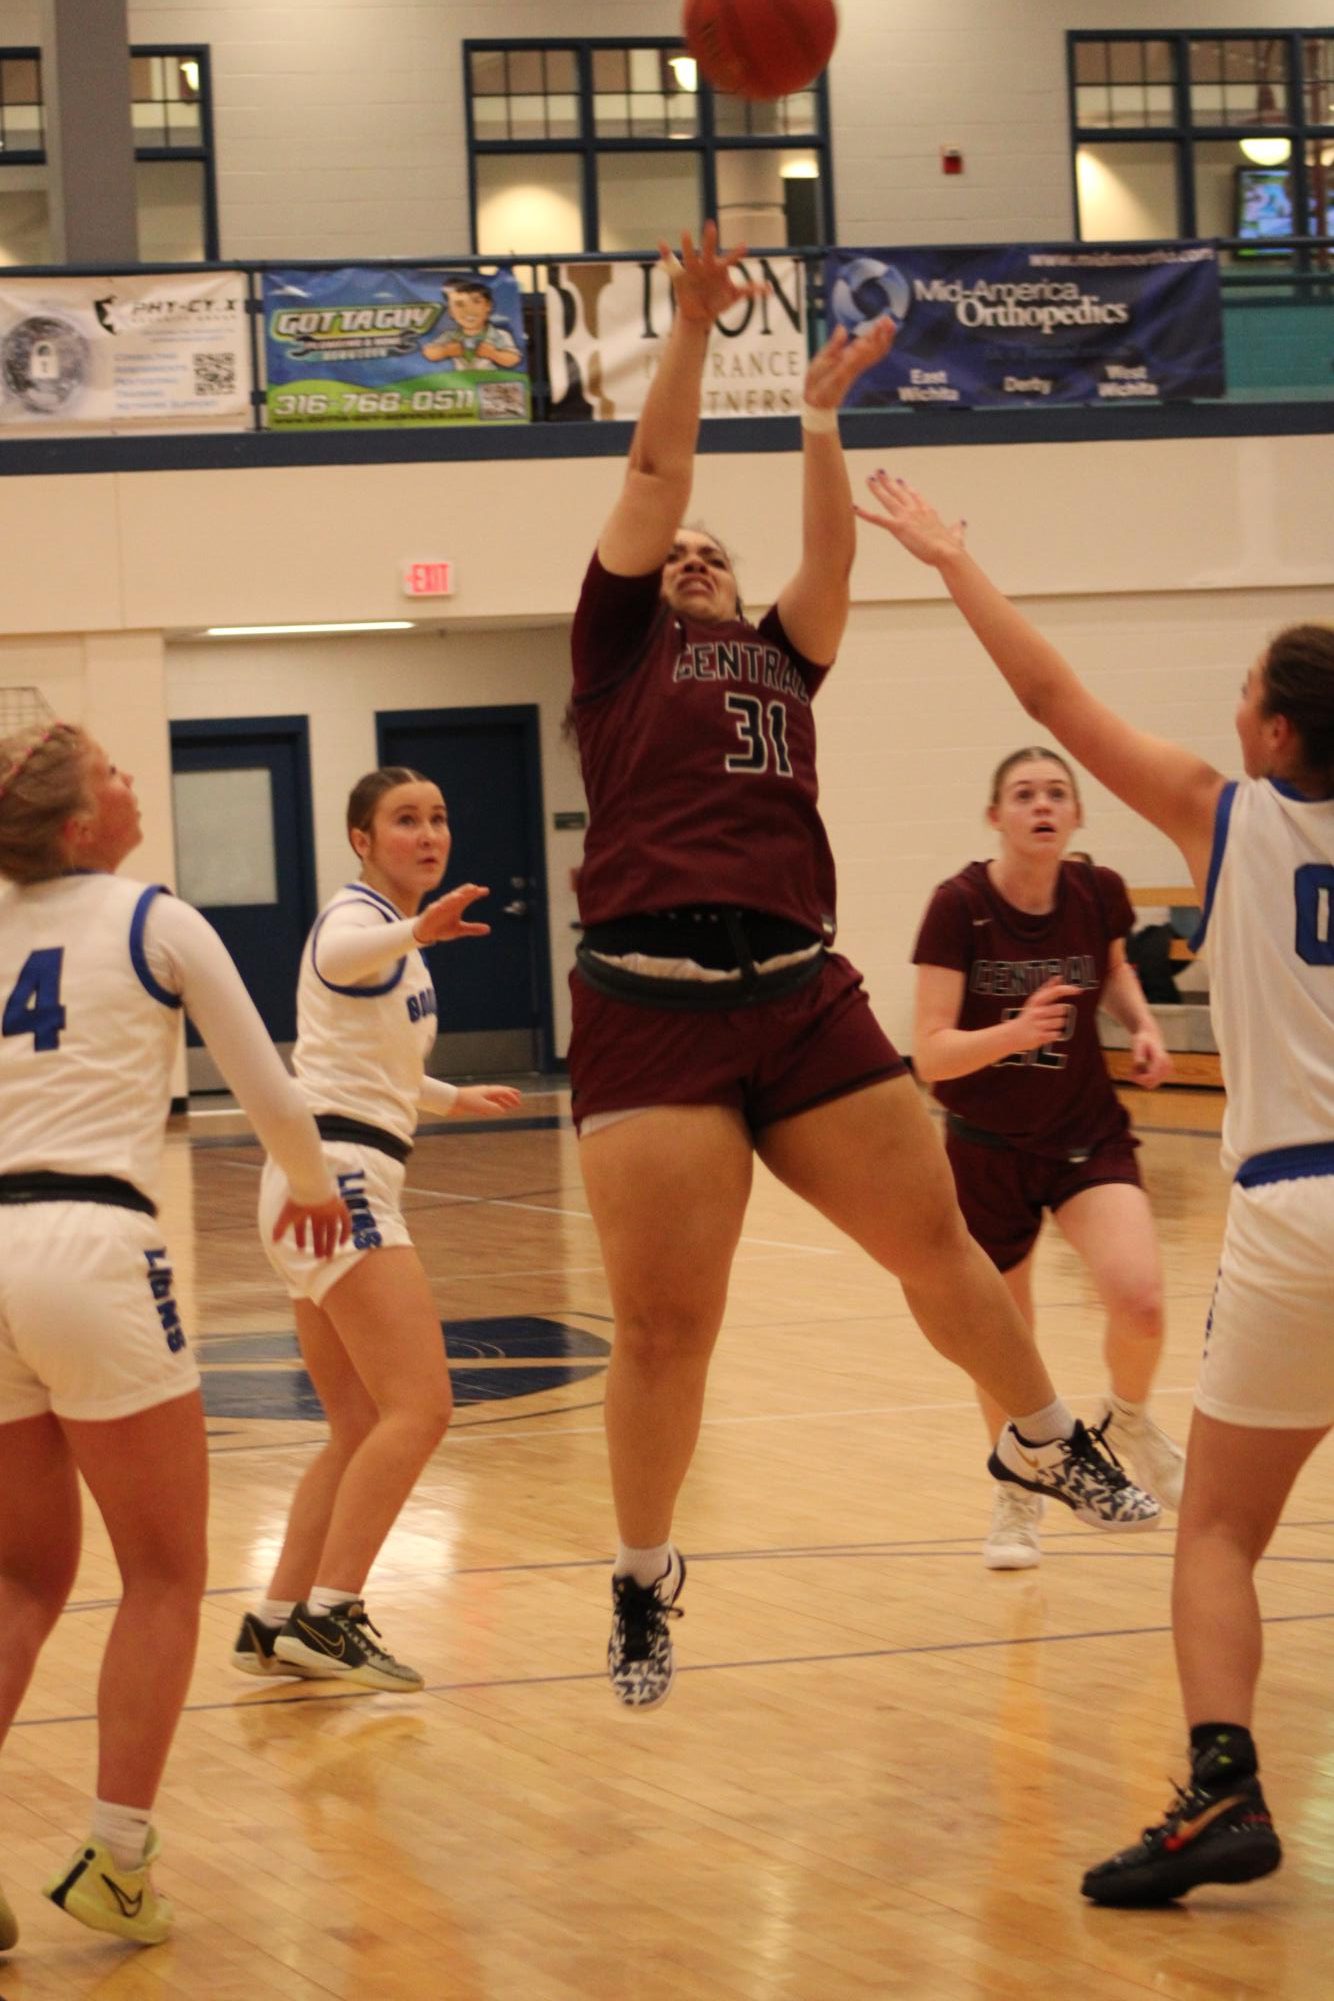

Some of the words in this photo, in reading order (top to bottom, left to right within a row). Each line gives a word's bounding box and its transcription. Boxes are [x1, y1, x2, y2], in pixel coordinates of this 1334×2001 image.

[640, 256, 803, 339] ION
[912, 279, 1079, 302] Mid-America
[956, 295, 1129, 334] Orthopedics
[673, 641, 809, 704] CENTRAL
[725, 690, 793, 778] 31
[1294, 863, 1334, 966] 0
[2, 945, 66, 1053] 4
